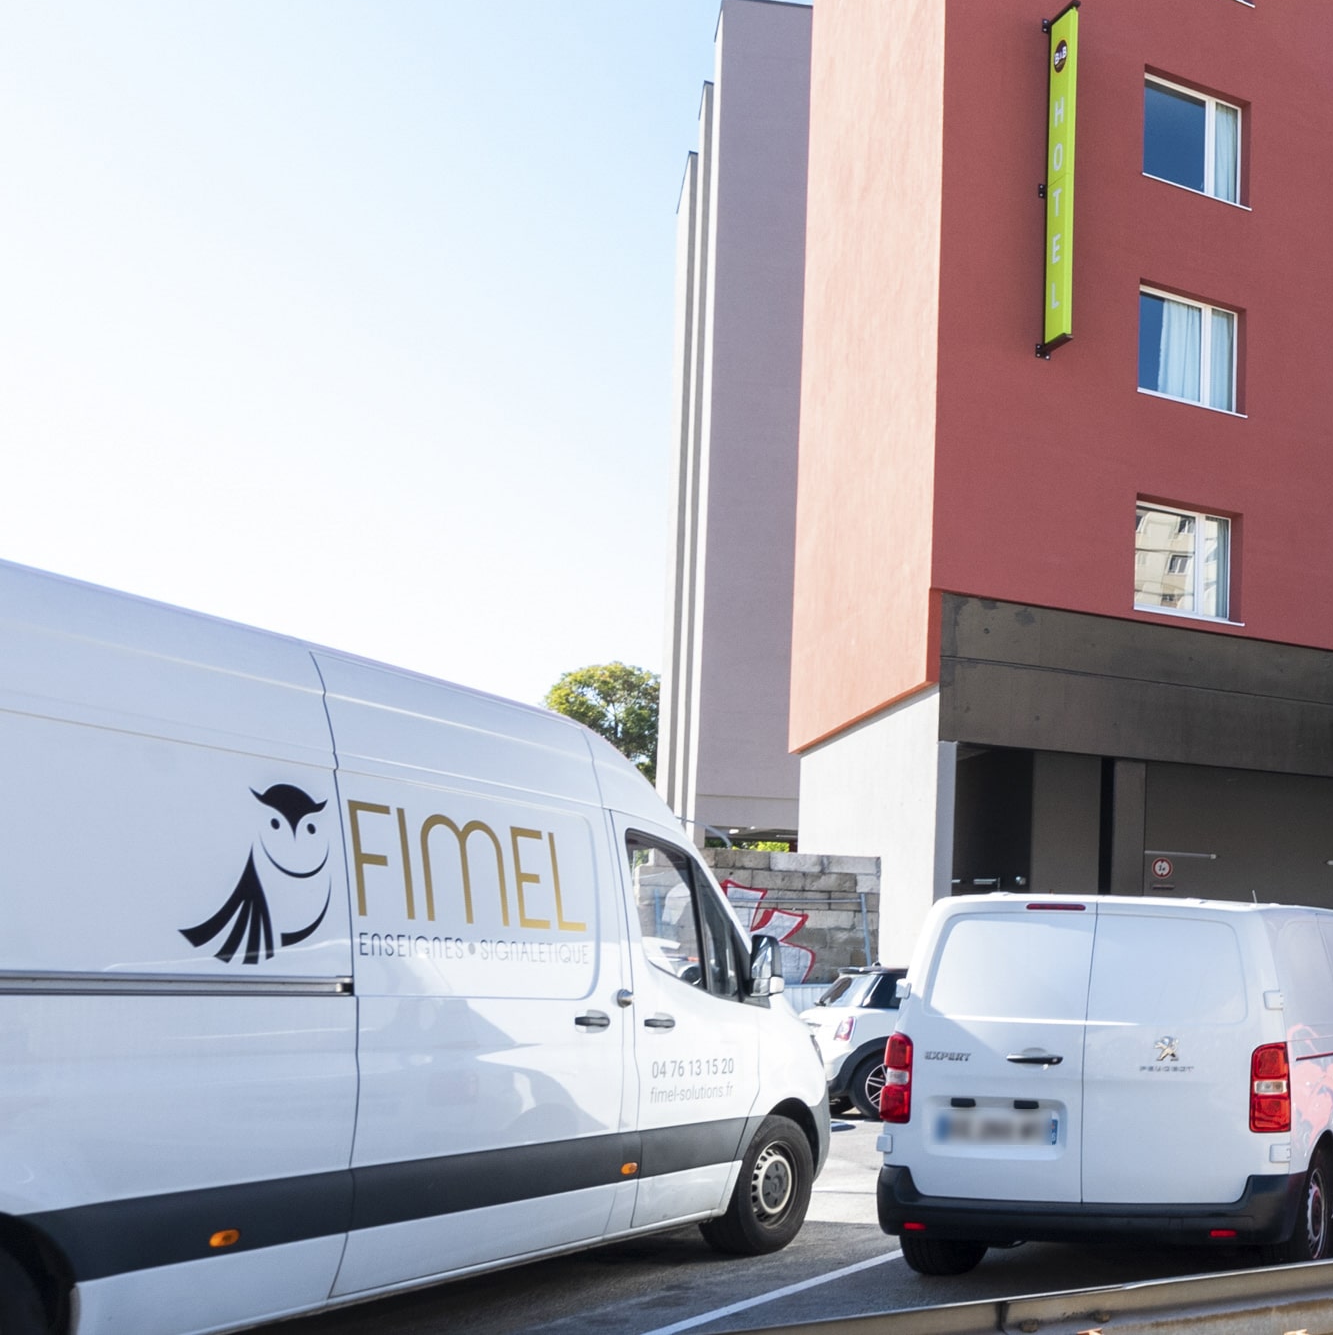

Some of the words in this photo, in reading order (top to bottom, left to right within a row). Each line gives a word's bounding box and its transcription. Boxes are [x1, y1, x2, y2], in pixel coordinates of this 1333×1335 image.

[1051, 96, 1064, 309] HOTEL
[347, 799, 587, 932] FIMEL
[359, 932, 463, 959] ENSEIGNES
[480, 939, 589, 964] SIGNALETIQUE
[652, 1061, 666, 1078] 04
[670, 1060, 684, 1077] 76
[689, 1059, 702, 1076] 13
[706, 1058, 718, 1075] 15
[721, 1058, 734, 1074] 20
[650, 1081, 733, 1103] fimel-solutions.fr
